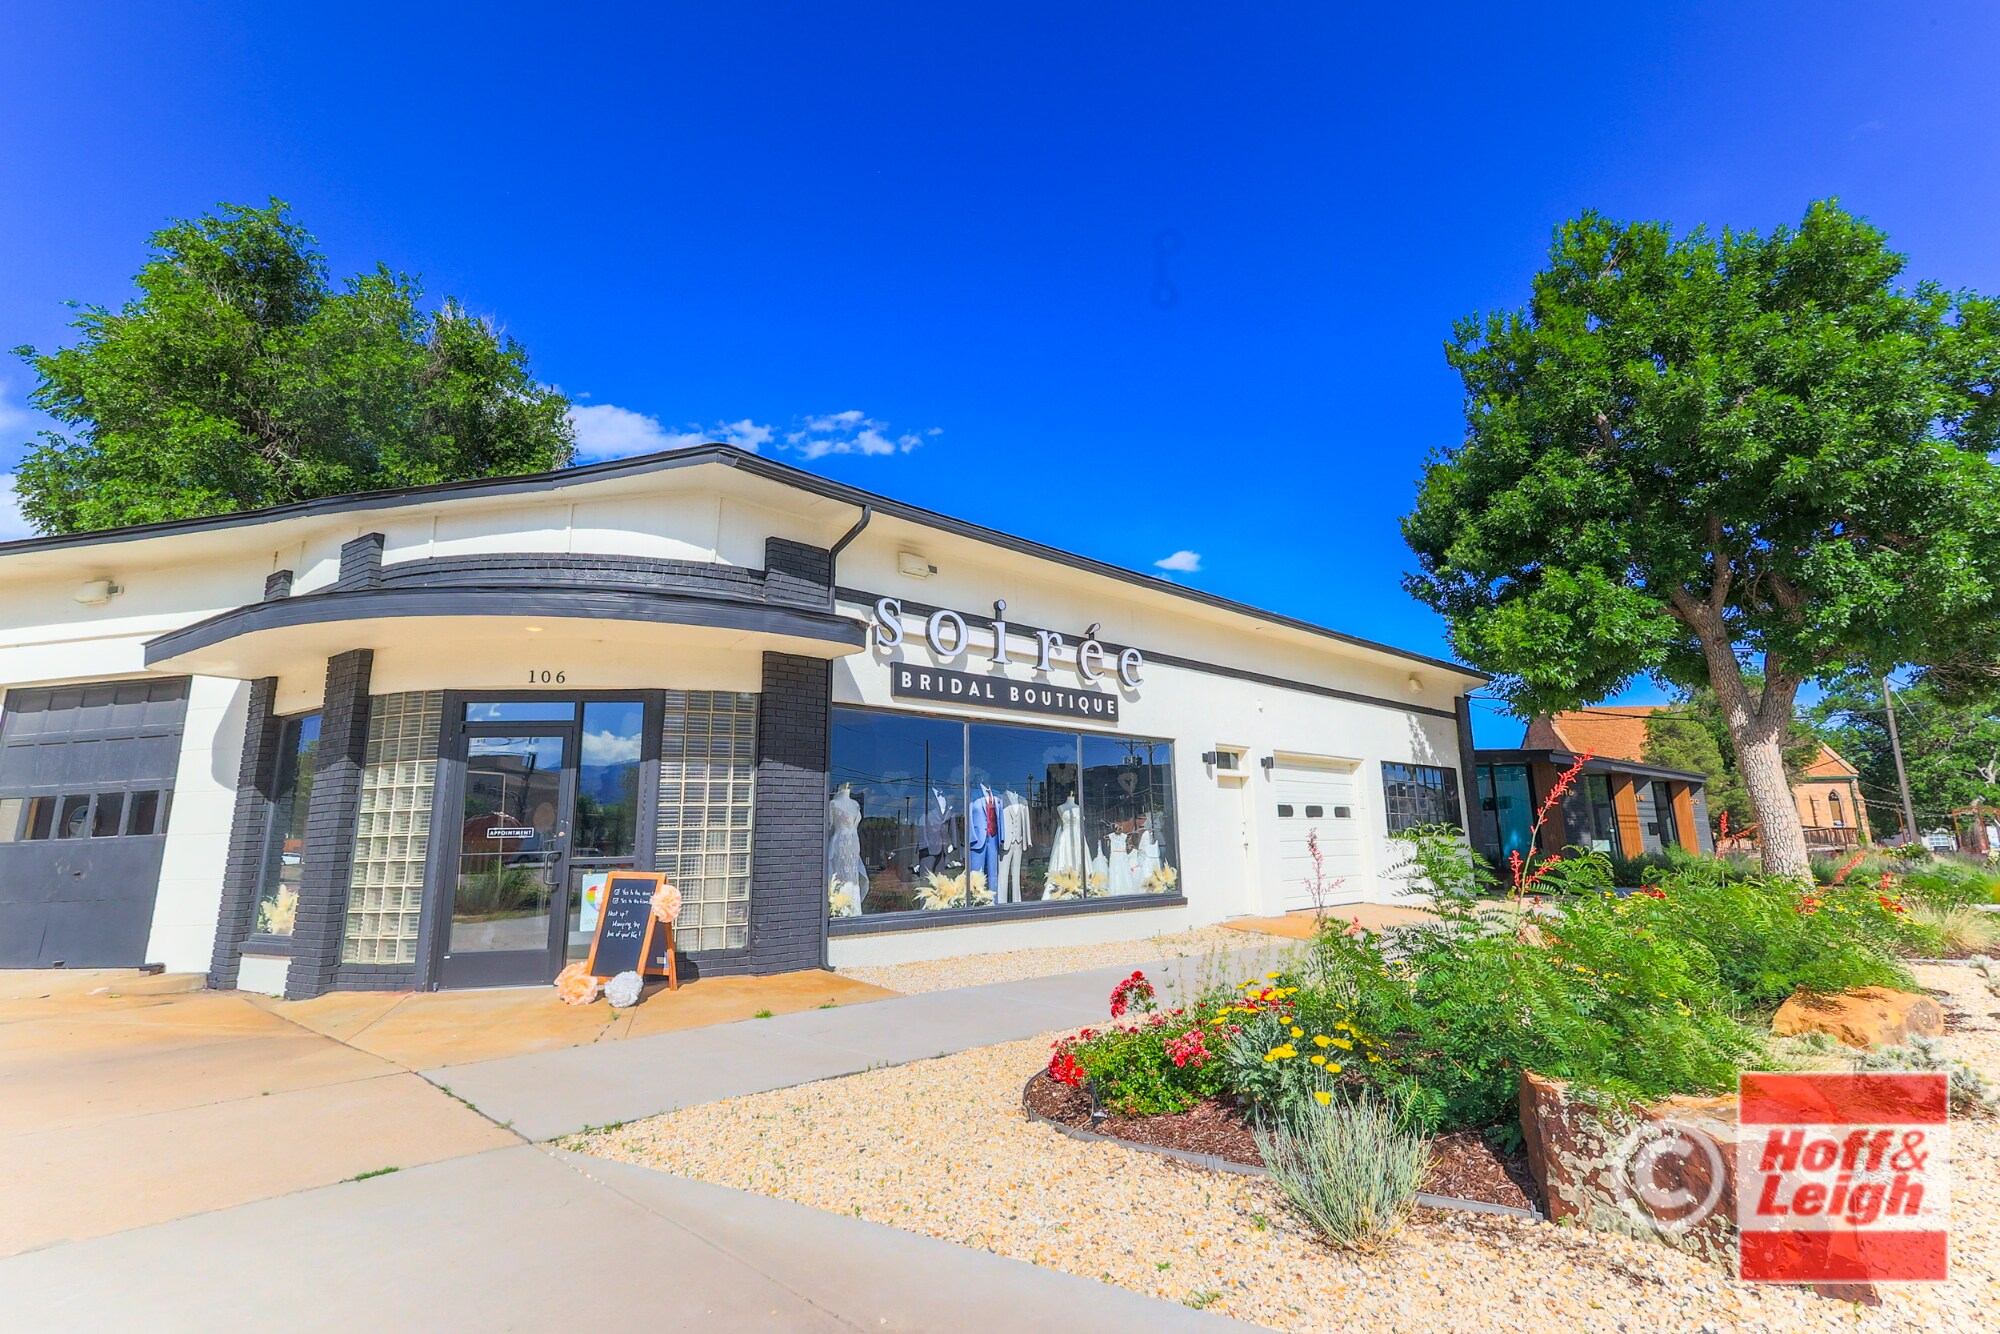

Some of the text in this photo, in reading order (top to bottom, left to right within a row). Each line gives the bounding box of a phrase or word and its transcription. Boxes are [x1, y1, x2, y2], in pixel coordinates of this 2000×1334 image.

[528, 670, 566, 684] 106
[901, 671, 1116, 715] BRIDAL BOUTIQUE
